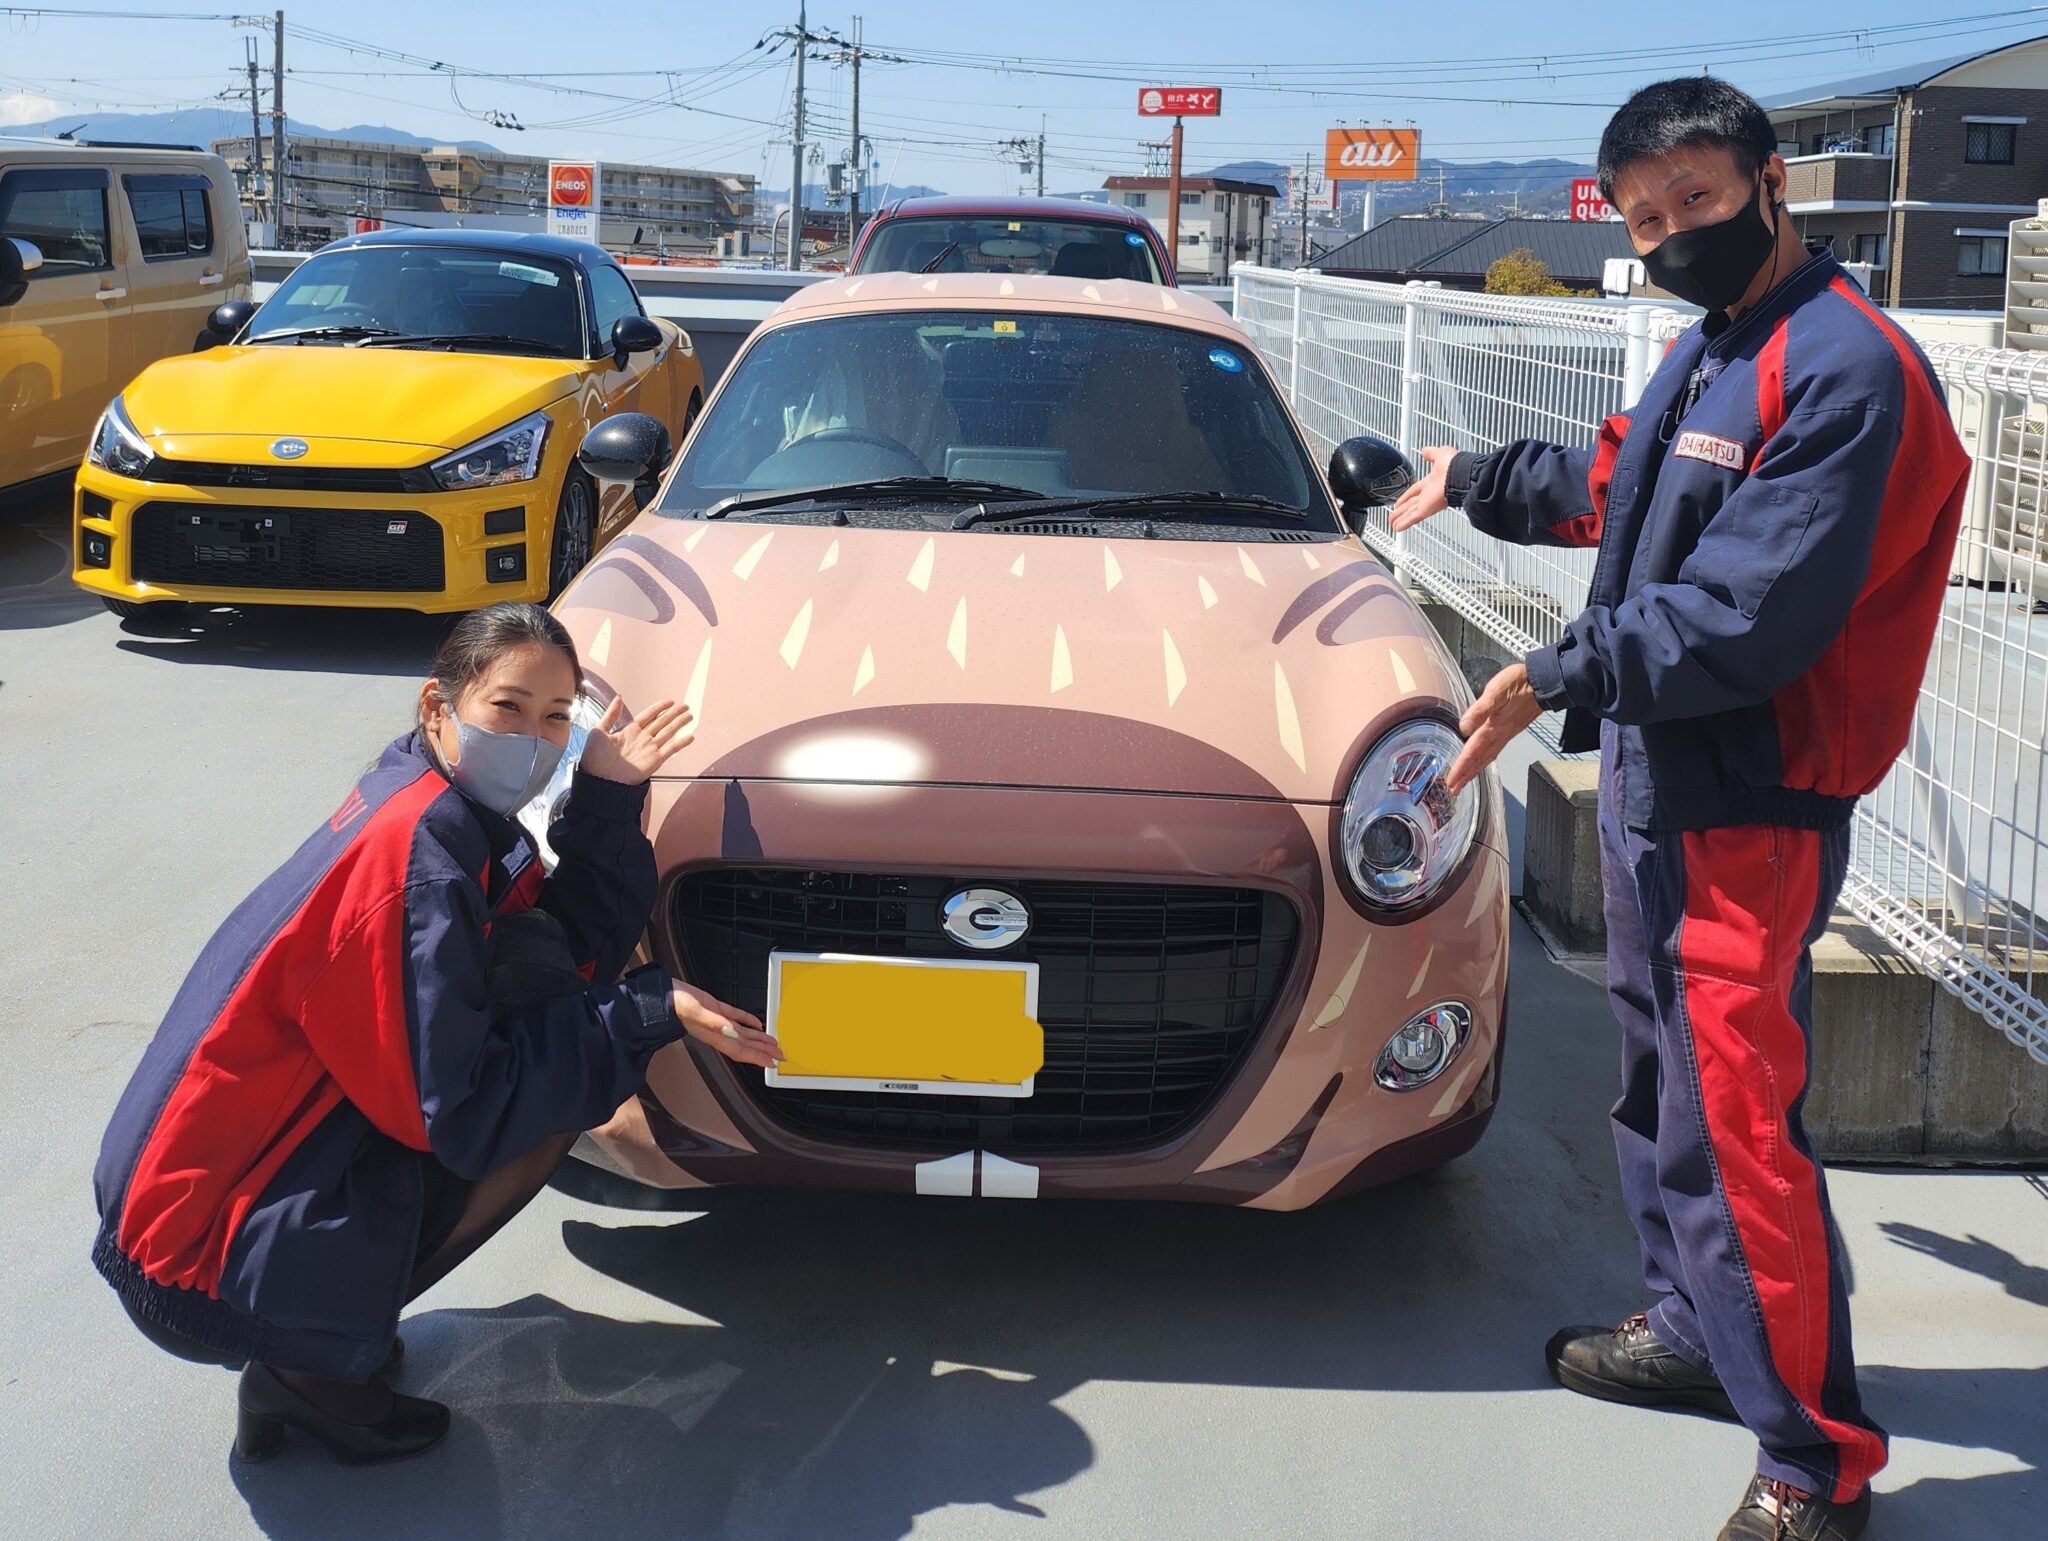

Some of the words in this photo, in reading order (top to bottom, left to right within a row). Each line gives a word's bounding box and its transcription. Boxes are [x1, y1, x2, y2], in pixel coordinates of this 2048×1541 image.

[1186, 93, 1214, 109] さと
[1340, 142, 1403, 167] au
[555, 180, 586, 190] ENEOS
[1577, 185, 1602, 201] UN
[556, 208, 586, 220] Enejet
[1576, 203, 1611, 221] QLO
[1680, 436, 1736, 461] DAIHATSU
